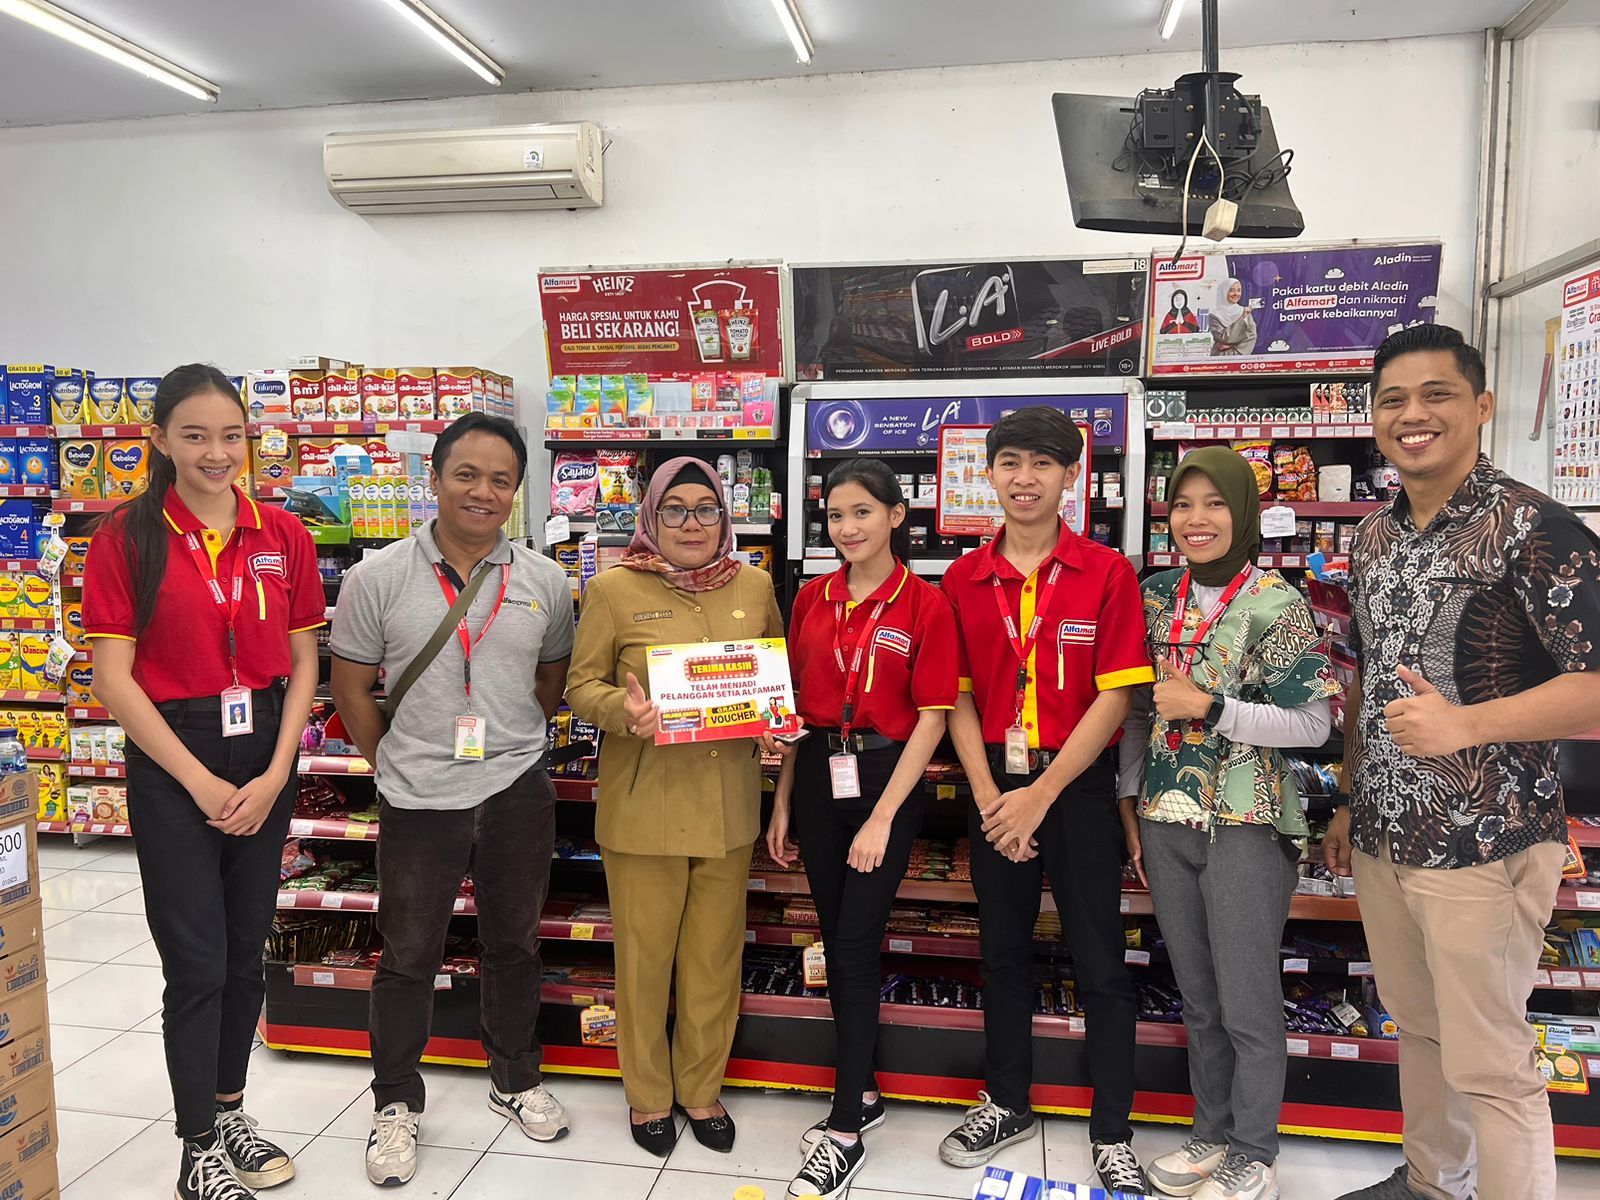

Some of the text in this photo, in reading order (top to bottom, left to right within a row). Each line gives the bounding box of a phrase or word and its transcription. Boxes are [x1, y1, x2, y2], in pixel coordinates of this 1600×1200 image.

[1134, 259, 1147, 271] 18
[1373, 252, 1412, 266] Aladin
[1158, 262, 1198, 272] Alfamart
[543, 277, 577, 288] Alfamart
[592, 276, 634, 293] HEINZ
[1272, 281, 1409, 297] Pakai kartu debit Aladin
[1272, 294, 1407, 310] di Alfamart dan nikmati
[559, 309, 679, 322] HARGA SPESIAL UNTUK KAMU
[1279, 308, 1397, 322] banyak kebaikannya!
[561, 321, 680, 339] BELI SEKARANG!
[971, 332, 1011, 347] BOLD
[1091, 328, 1132, 353] LIVE BOLD
[10, 381, 42, 392] LACTOGROW
[54, 386, 82, 394] Nutribaby
[92, 386, 121, 394] Nutribaby
[327, 384, 358, 392] chil-kid
[364, 383, 396, 392] chil-kid
[33, 395, 41, 407] 3
[286, 403, 291, 412] 3
[19, 446, 48, 454] LACTOGROW
[68, 451, 91, 459] Bebelac
[112, 452, 138, 462] Bebelac
[326, 468, 332, 477] 2
[561, 465, 595, 479] Sayang
[239, 477, 247, 487] 3
[20, 529, 28, 542] 4
[26, 583, 50, 593] Dancow
[1003, 616, 1014, 639] Alfamart
[1033, 616, 1043, 639] Alfamart
[878, 630, 910, 647] Alfamart
[8, 660, 18, 669] 3+
[850, 647, 861, 672] Alfamart
[691, 661, 752, 675] TERIMA KASIH
[660, 683, 786, 701] PELANGGAN SETIA ALFAMART
[690, 680, 756, 692] TELAH MENJADI
[716, 703, 746, 714] GRATIS
[710, 710, 757, 724] VOUCHER
[1548, 1026, 1570, 1035] Ricola
